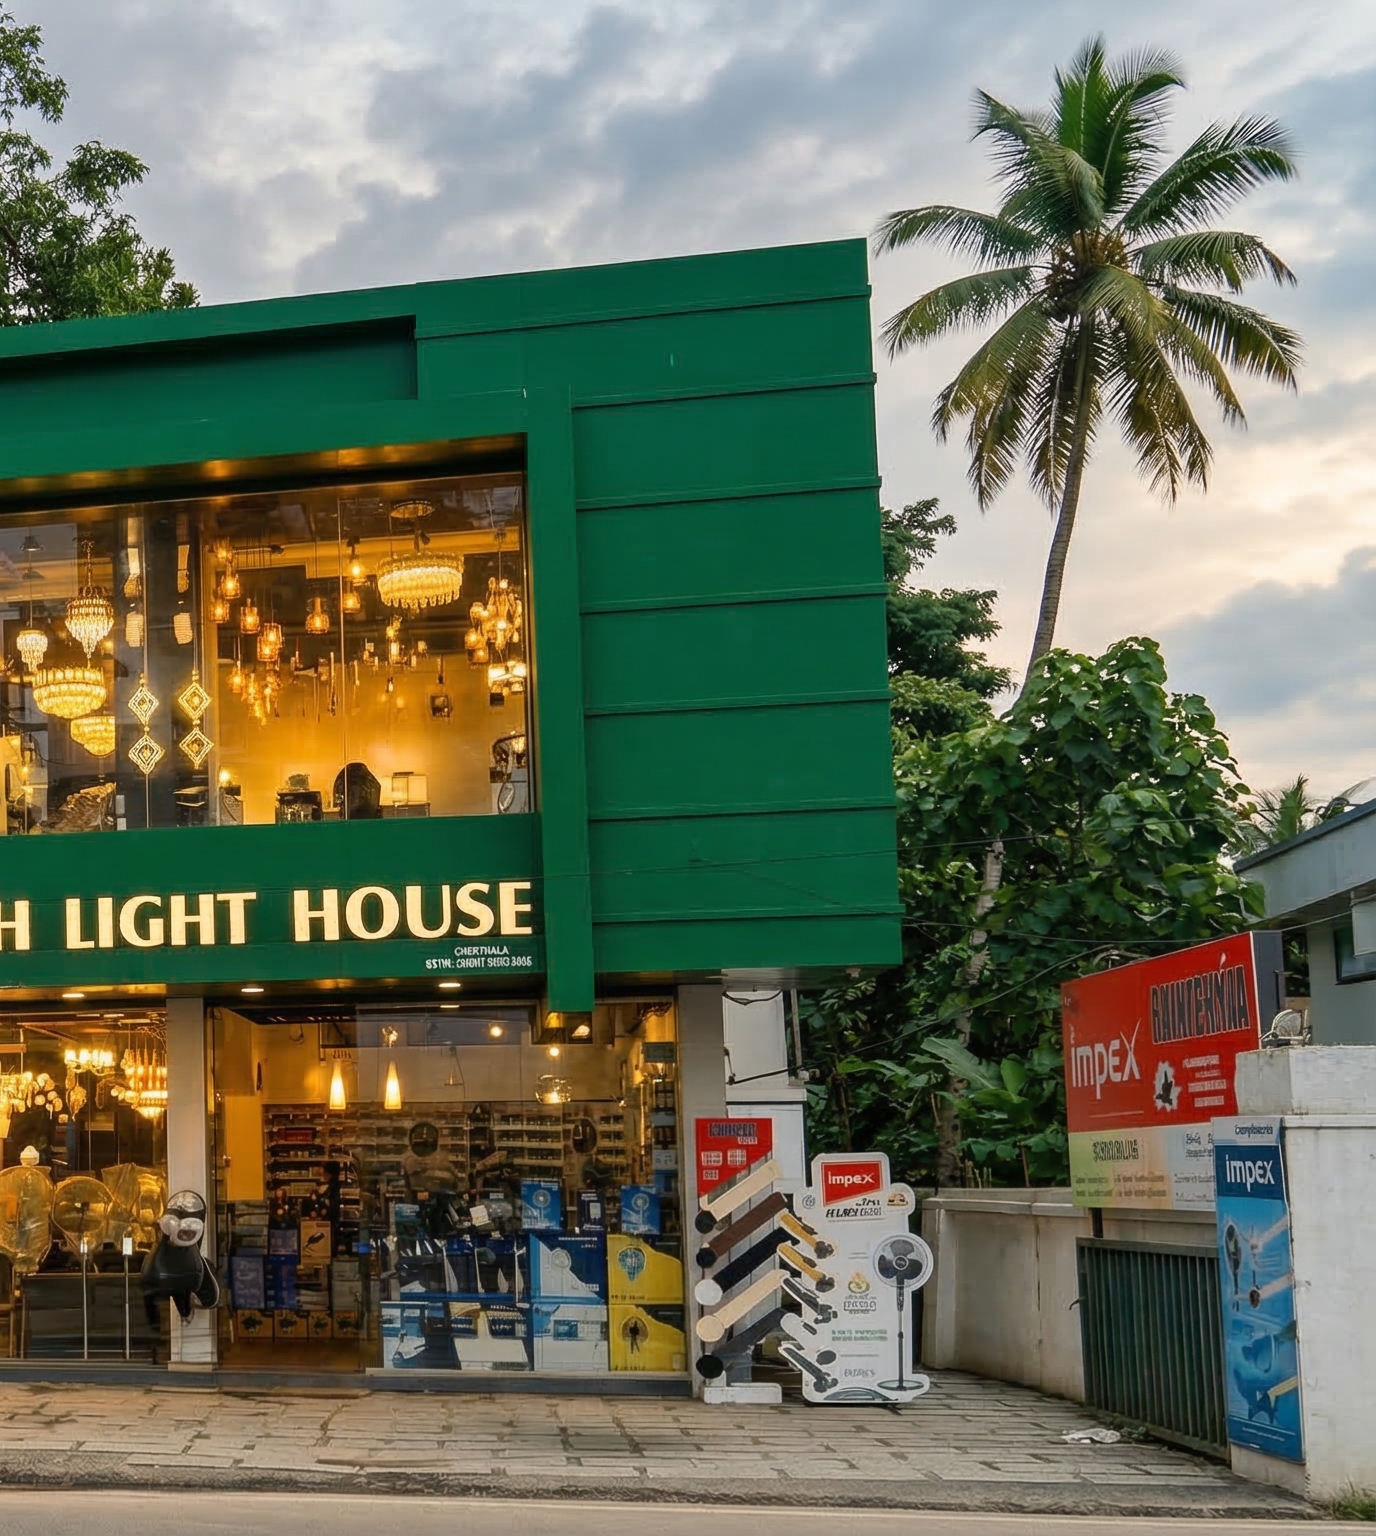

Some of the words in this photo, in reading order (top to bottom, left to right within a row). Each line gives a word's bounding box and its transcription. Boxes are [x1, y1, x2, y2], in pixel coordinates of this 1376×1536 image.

[64, 890, 257, 951] LIGHT
[292, 881, 534, 942] HOUSE
[827, 1171, 875, 1188] impex
[1225, 1154, 1275, 1193] impex
